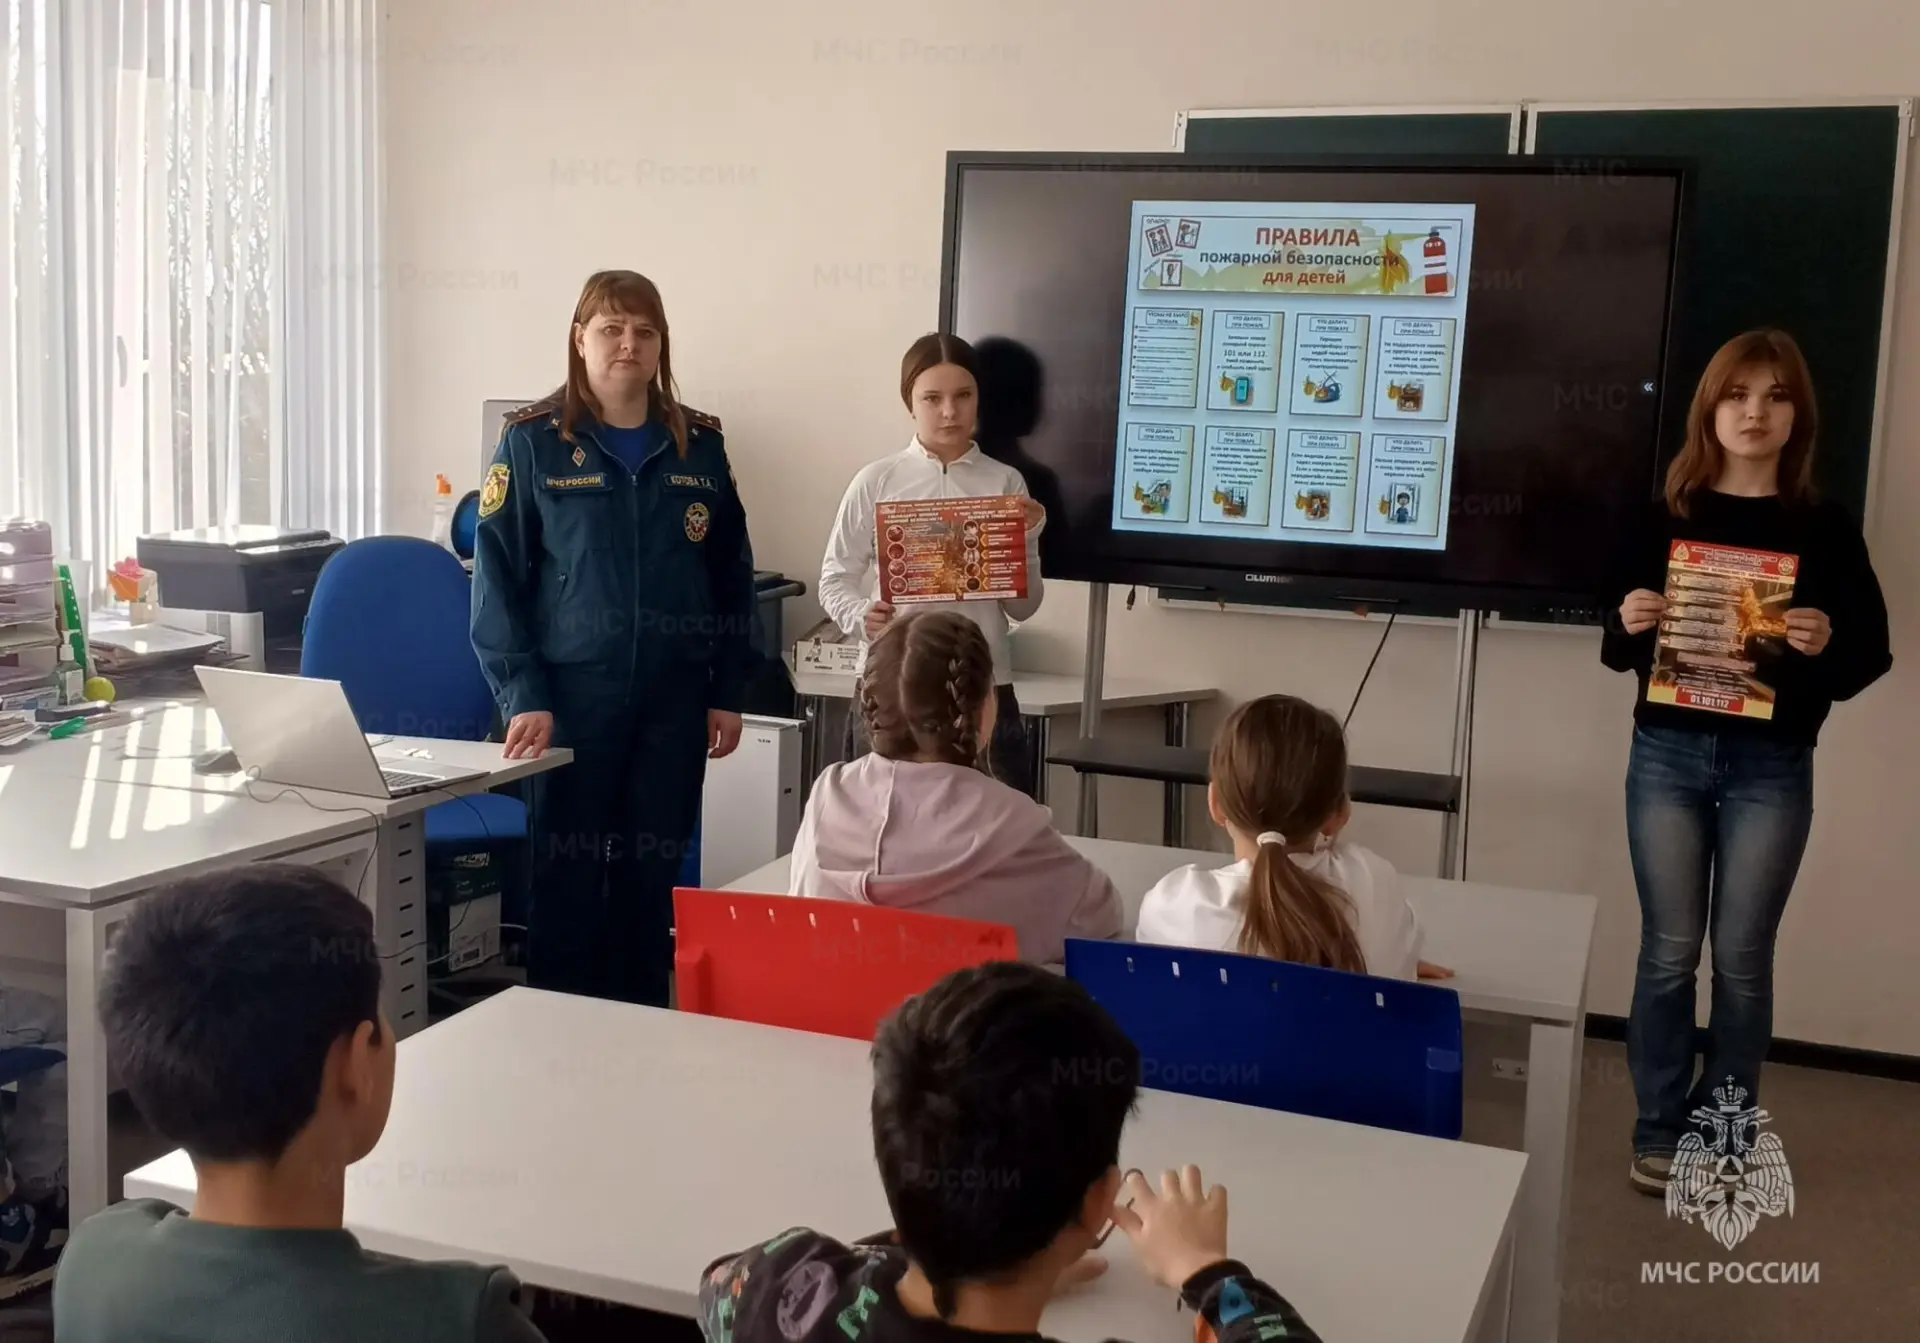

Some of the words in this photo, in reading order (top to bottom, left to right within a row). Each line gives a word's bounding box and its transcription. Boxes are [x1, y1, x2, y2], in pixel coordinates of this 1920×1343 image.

[1256, 227, 1360, 246] ПРАВИЛА
[1199, 250, 1281, 267] пожарной
[1287, 251, 1399, 267] безопасности
[1263, 271, 1293, 285] для
[1297, 270, 1346, 285] детей
[546, 477, 565, 487] МЧС
[566, 475, 601, 486] РОССИИ
[670, 475, 699, 486] КОТОВА
